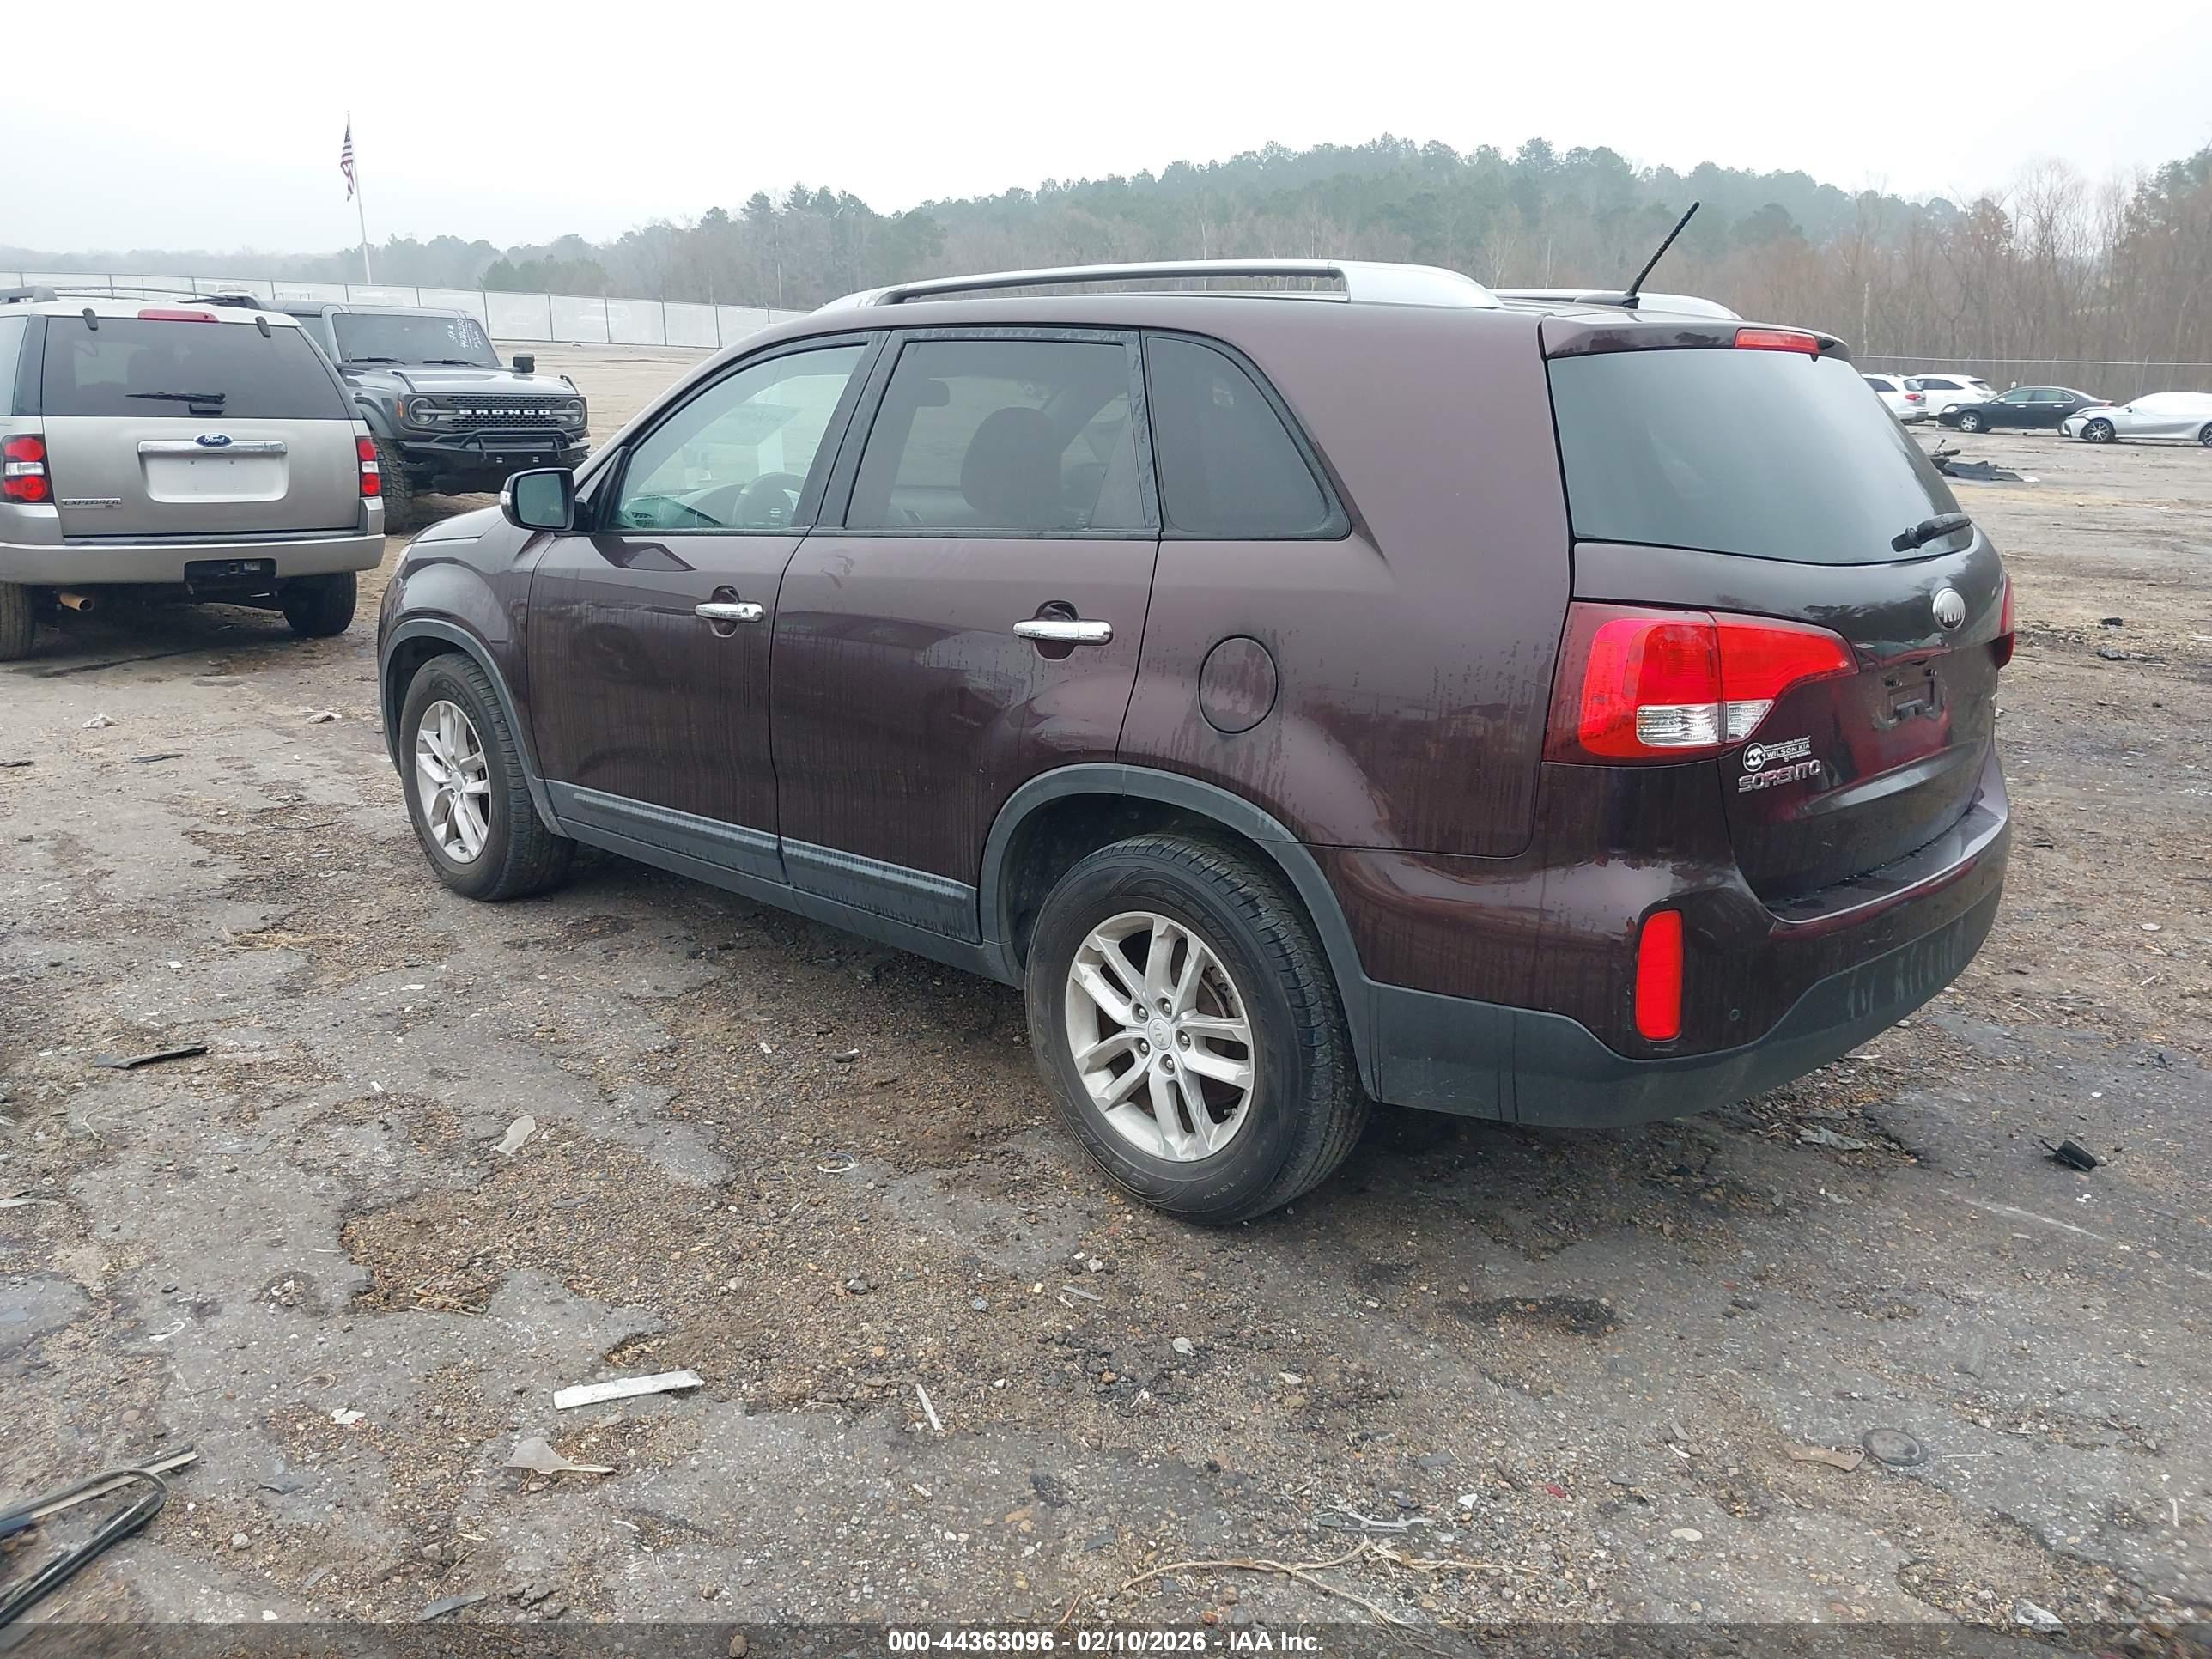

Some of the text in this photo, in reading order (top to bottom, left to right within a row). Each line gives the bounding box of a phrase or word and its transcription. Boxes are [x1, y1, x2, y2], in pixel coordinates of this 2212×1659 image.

[204, 434, 225, 444] Ford
[61, 497, 122, 506] EXPLORER
[1766, 747, 1797, 757] WILSON
[1799, 743, 1810, 751] KIA
[1738, 759, 1820, 793] SORENTO
[1153, 1022, 1164, 1047] KIA
